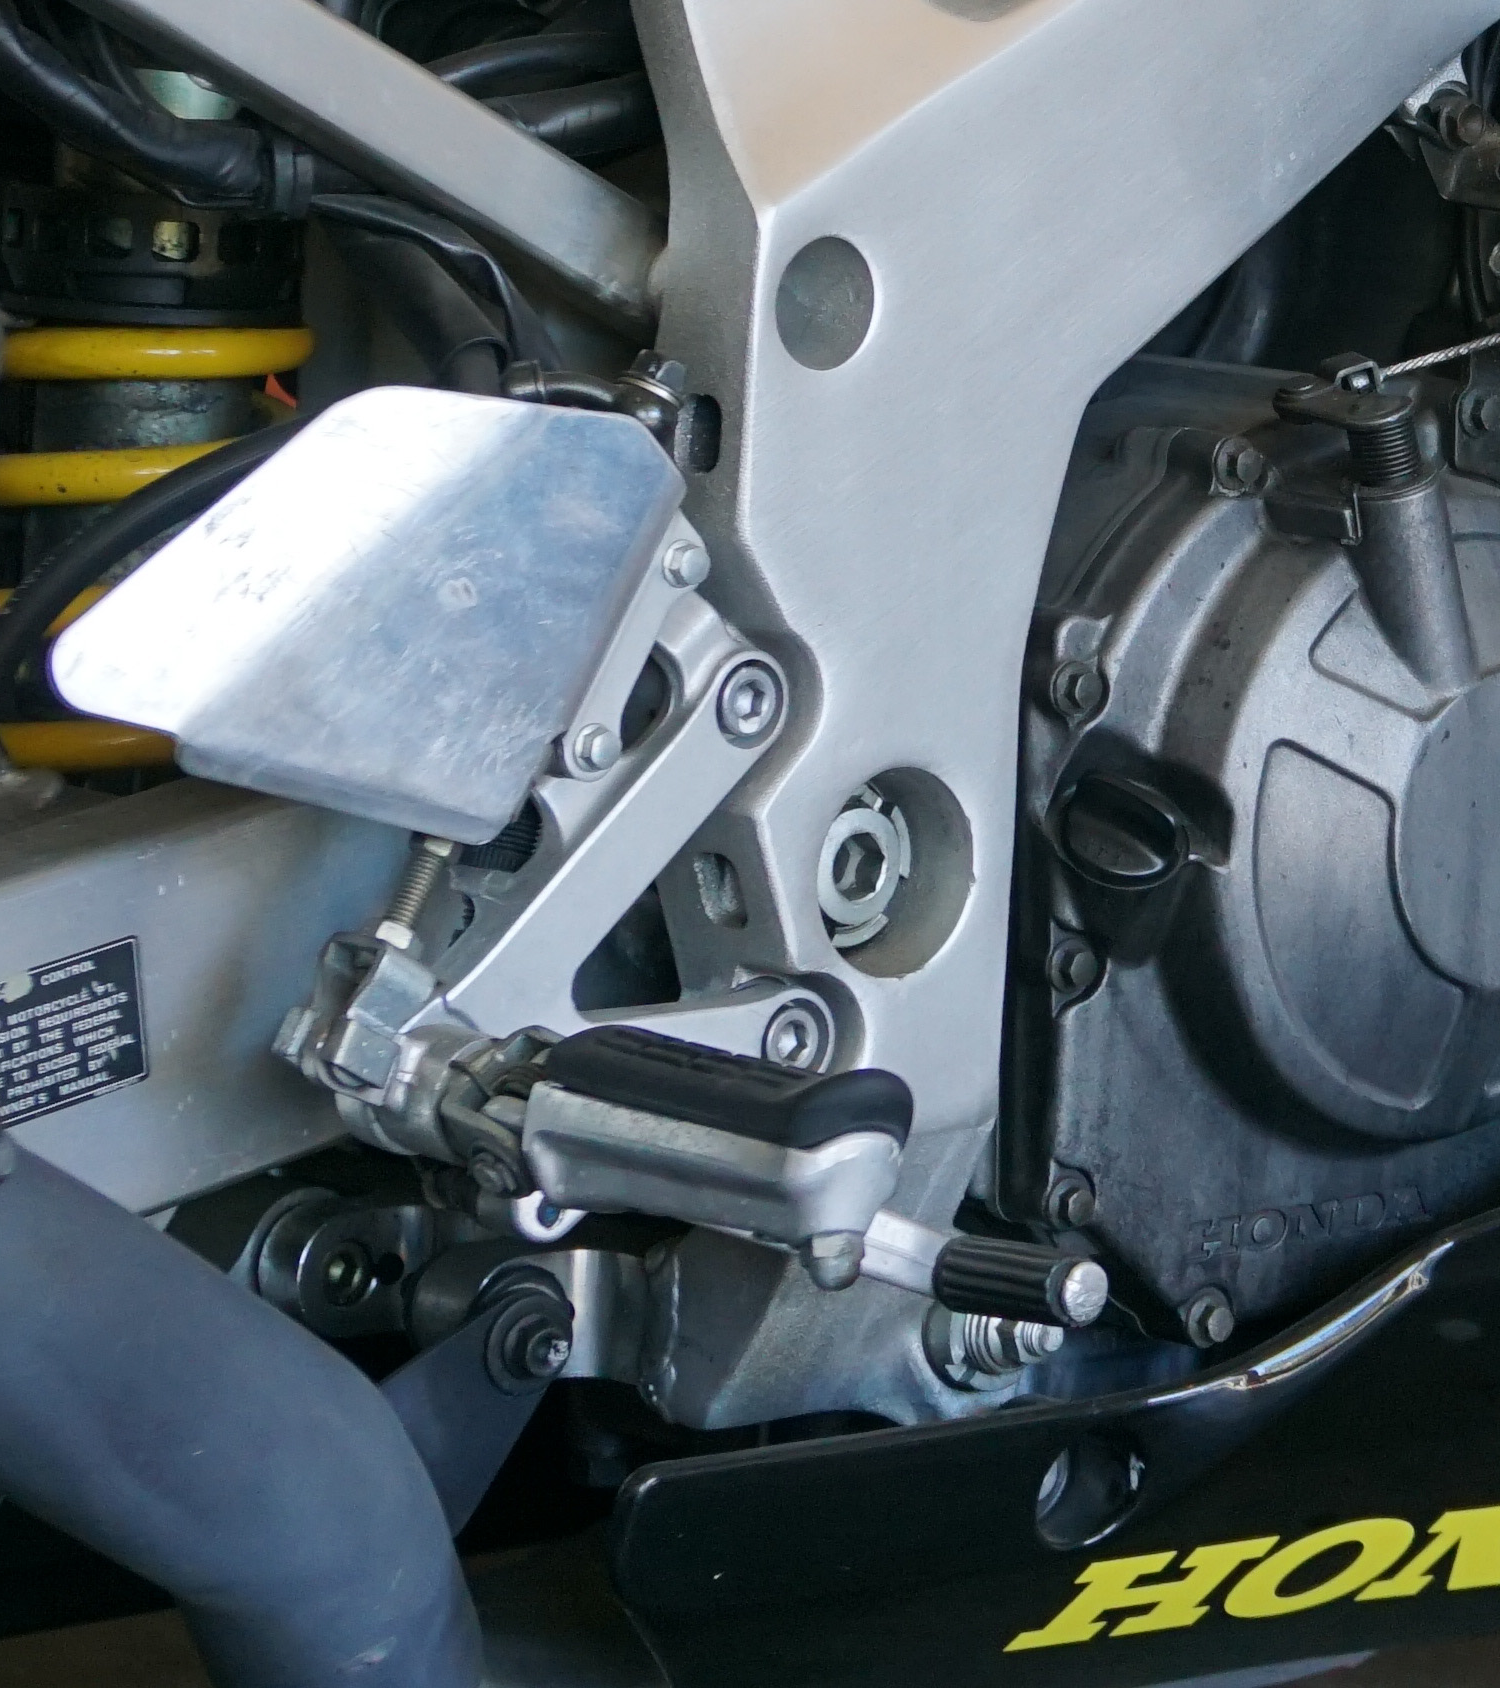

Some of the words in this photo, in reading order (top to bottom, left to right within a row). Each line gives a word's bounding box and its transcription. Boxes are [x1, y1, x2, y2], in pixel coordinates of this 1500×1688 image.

[40, 959, 95, 985] CONTROL
[37, 992, 128, 1029] REQUIREMENTS
[11, 1040, 29, 1053] BY
[39, 1028, 63, 1043] THE
[71, 1008, 122, 1033] FEDERAL
[73, 1025, 115, 1046] WHICH
[12, 1069, 29, 1082] TO
[36, 1052, 80, 1073] EXCEED
[87, 1033, 135, 1056] FEDERAL
[6, 1066, 80, 1099] PROHIBITED
[1183, 1182, 1430, 1259] HONDA
